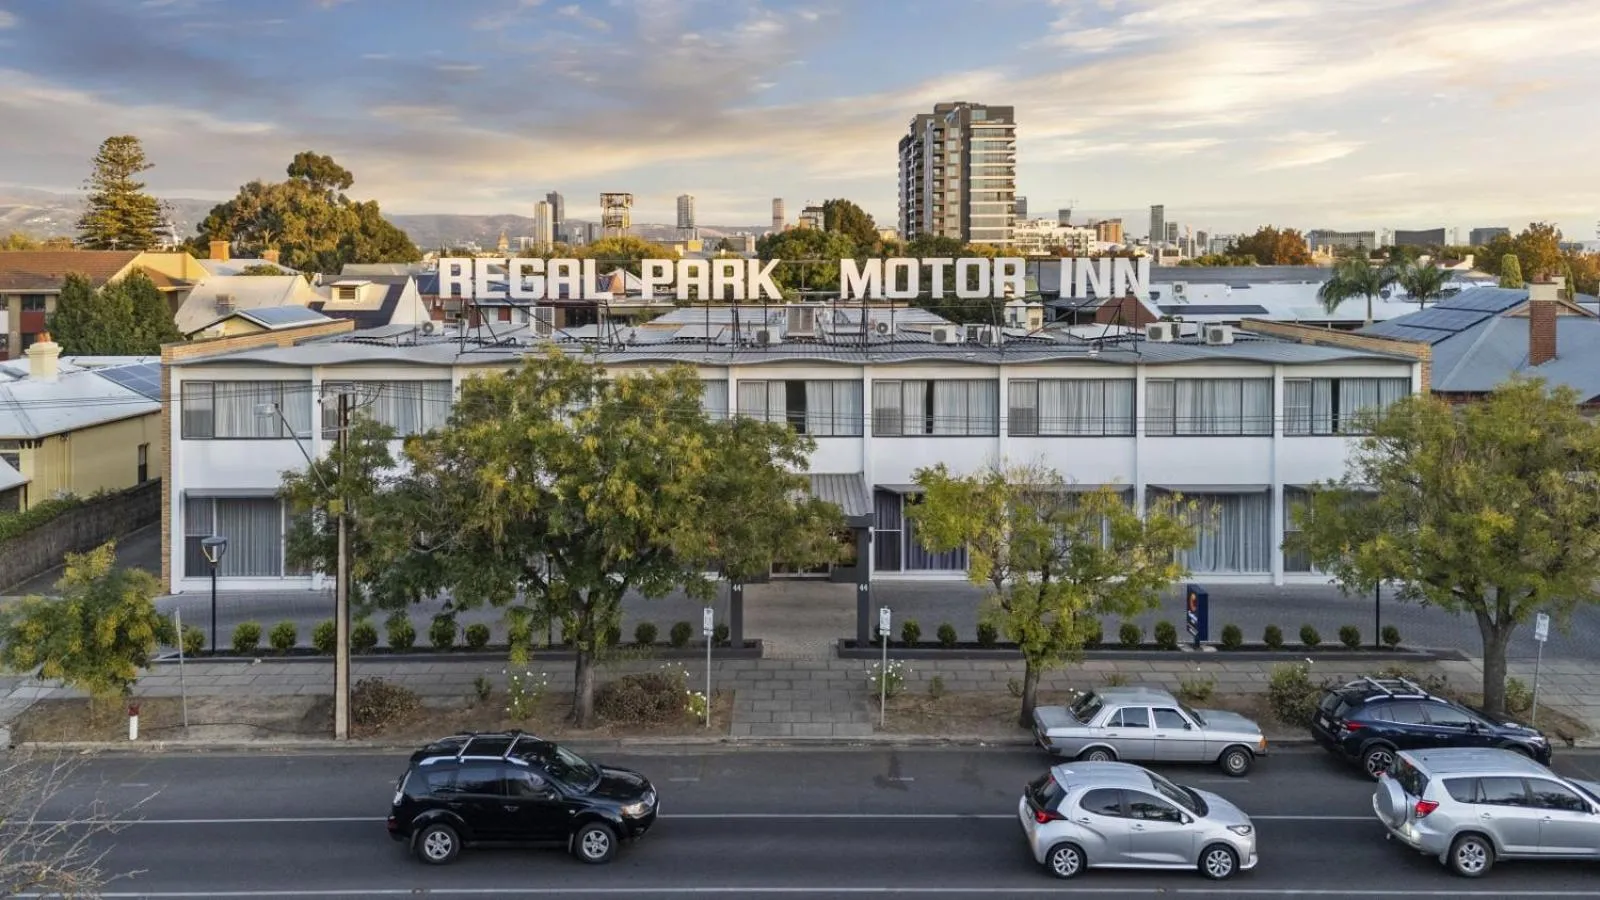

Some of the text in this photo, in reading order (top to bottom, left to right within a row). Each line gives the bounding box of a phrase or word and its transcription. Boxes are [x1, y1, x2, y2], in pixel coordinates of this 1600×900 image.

[439, 257, 1150, 300] REGAL PARK MOTOR INN
[732, 584, 742, 592] 44
[859, 584, 868, 592] 44
